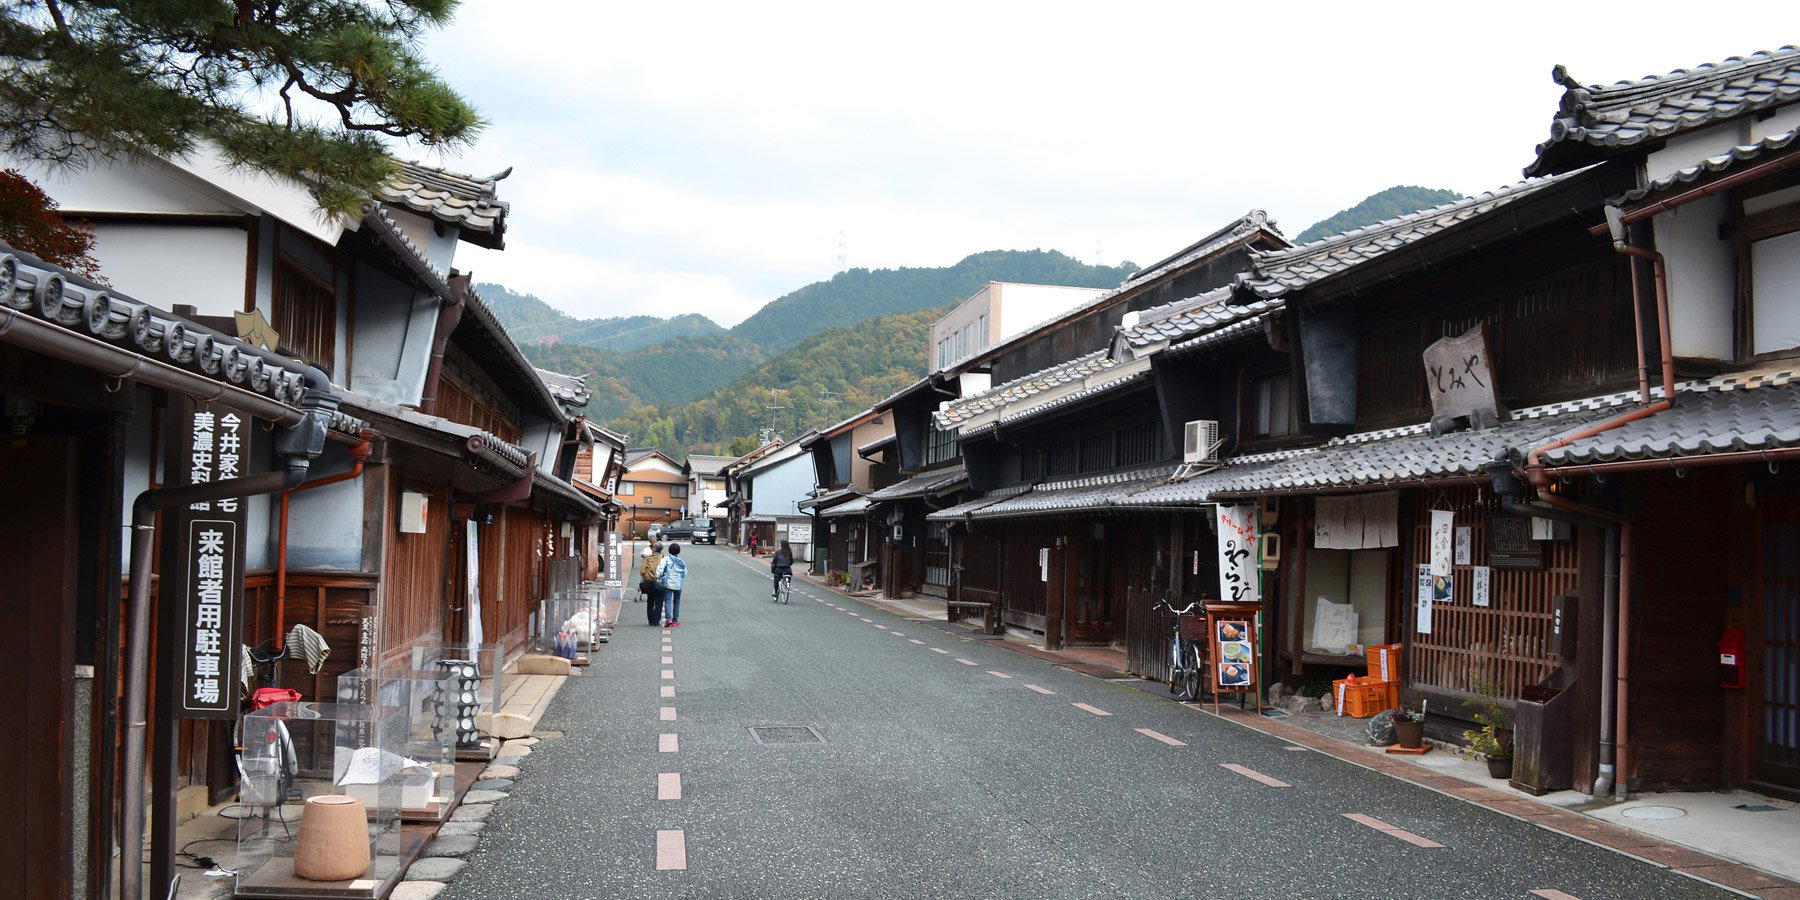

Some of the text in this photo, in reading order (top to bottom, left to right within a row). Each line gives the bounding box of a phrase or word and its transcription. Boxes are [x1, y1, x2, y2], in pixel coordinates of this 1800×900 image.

[1430, 354, 1485, 393] とみや
[1221, 514, 1245, 535] クリーム
[1245, 513, 1256, 547] とみや
[1224, 540, 1253, 601] わらび
[194, 529, 224, 704] 来館者用駐車場
